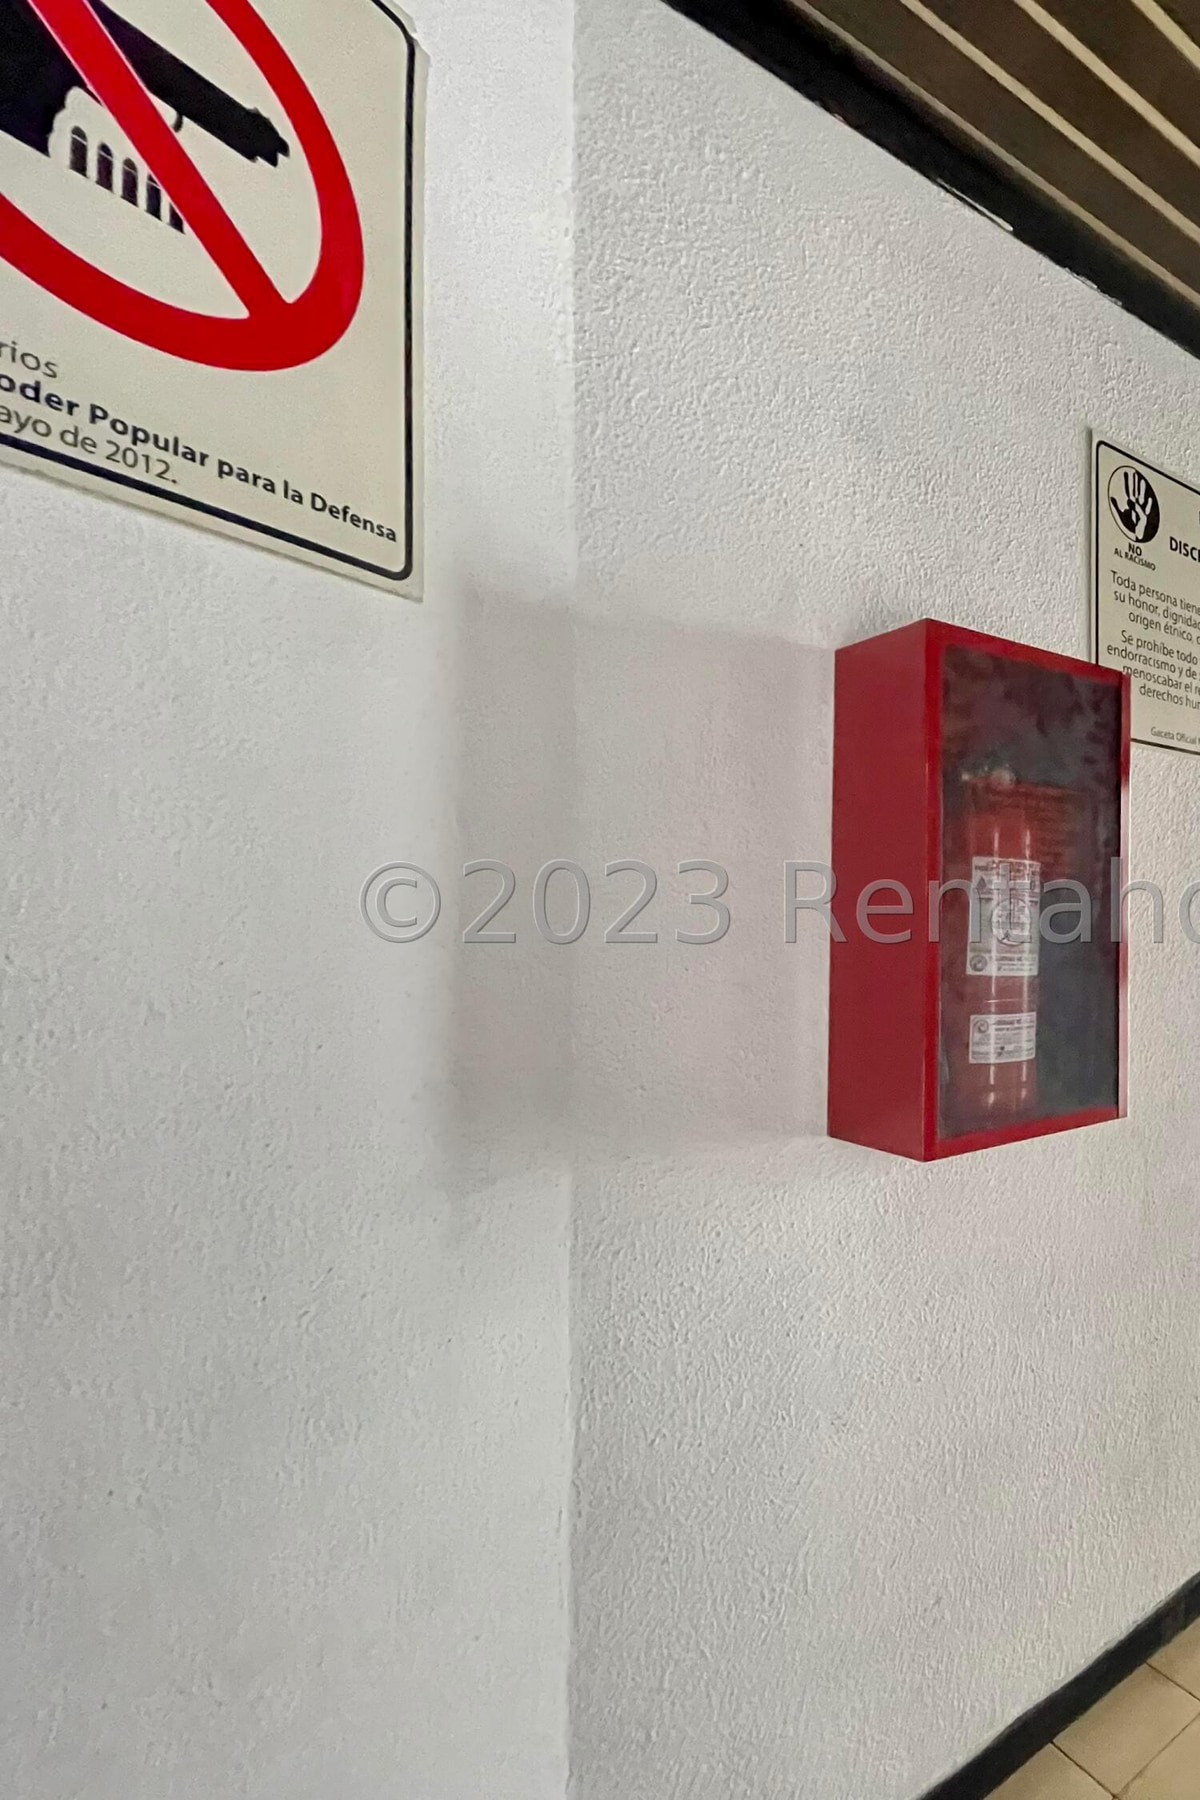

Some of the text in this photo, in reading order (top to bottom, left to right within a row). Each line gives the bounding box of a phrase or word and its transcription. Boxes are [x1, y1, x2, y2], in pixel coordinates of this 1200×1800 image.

[0, 405, 178, 484] ayo de 2012.
[0, 374, 397, 542] oder Popular para la Defensa
[1113, 547, 1155, 571] AL RACISMO
[1128, 542, 1142, 556] NO
[1110, 569, 1136, 593] Toda
[1138, 583, 1177, 607] persona
[1113, 590, 1125, 602] su
[1128, 592, 1160, 616] honor,
[1128, 611, 1161, 631] origen
[1121, 629, 1133, 645] Se
[1176, 649, 1198, 665] todo
[1106, 644, 1176, 673] endorracismo
[1177, 666, 1183, 677] y
[1185, 666, 1197, 679] de
[1122, 665, 1182, 689] menoscabar
[1184, 681, 1192, 693] el
[1138, 683, 1183, 705] derechos
